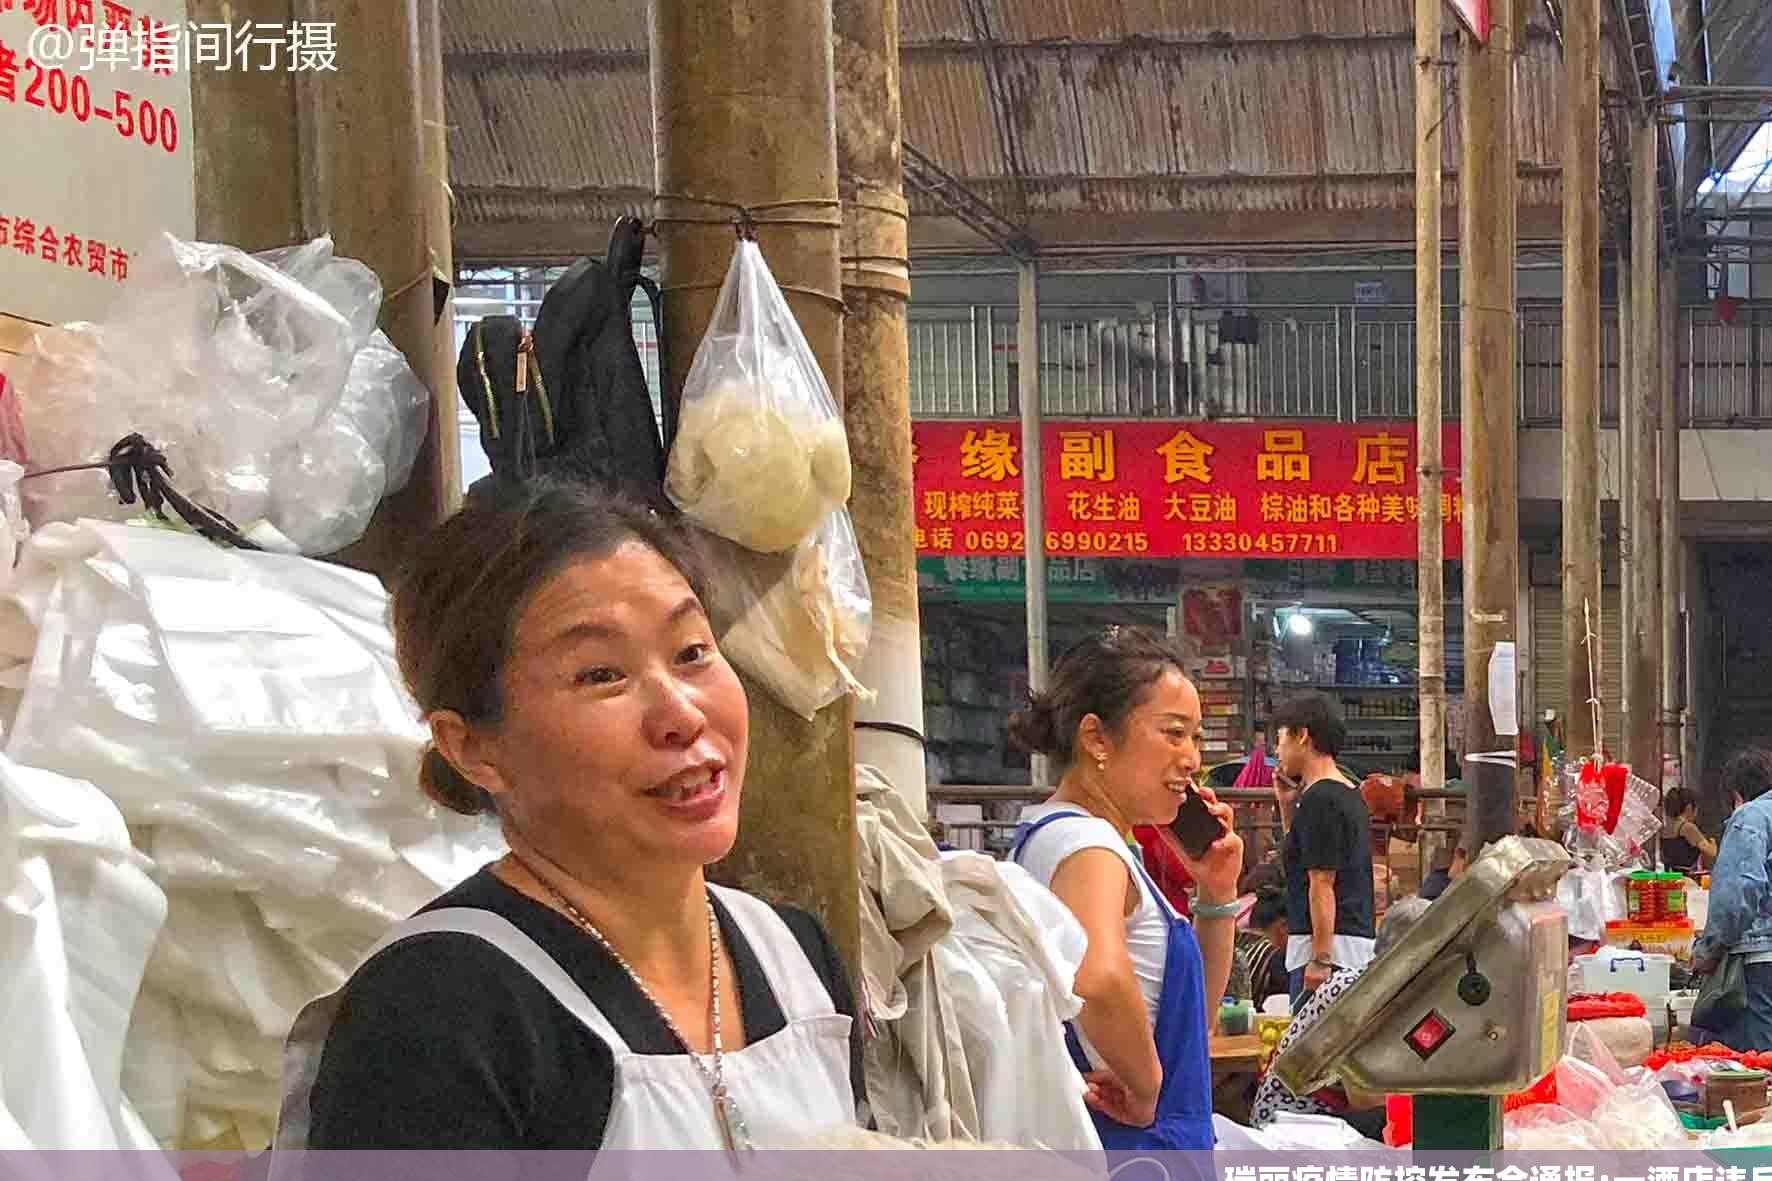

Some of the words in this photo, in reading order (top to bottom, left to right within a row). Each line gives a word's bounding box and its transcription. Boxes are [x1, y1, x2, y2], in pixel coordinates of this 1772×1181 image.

[911, 428, 1410, 485] 缘副食品店
[924, 489, 1025, 521] 现榨纯菜
[1067, 490, 1141, 522] 花生油
[1163, 490, 1238, 523] 大豆油
[1181, 532, 1338, 553] 13330457711
